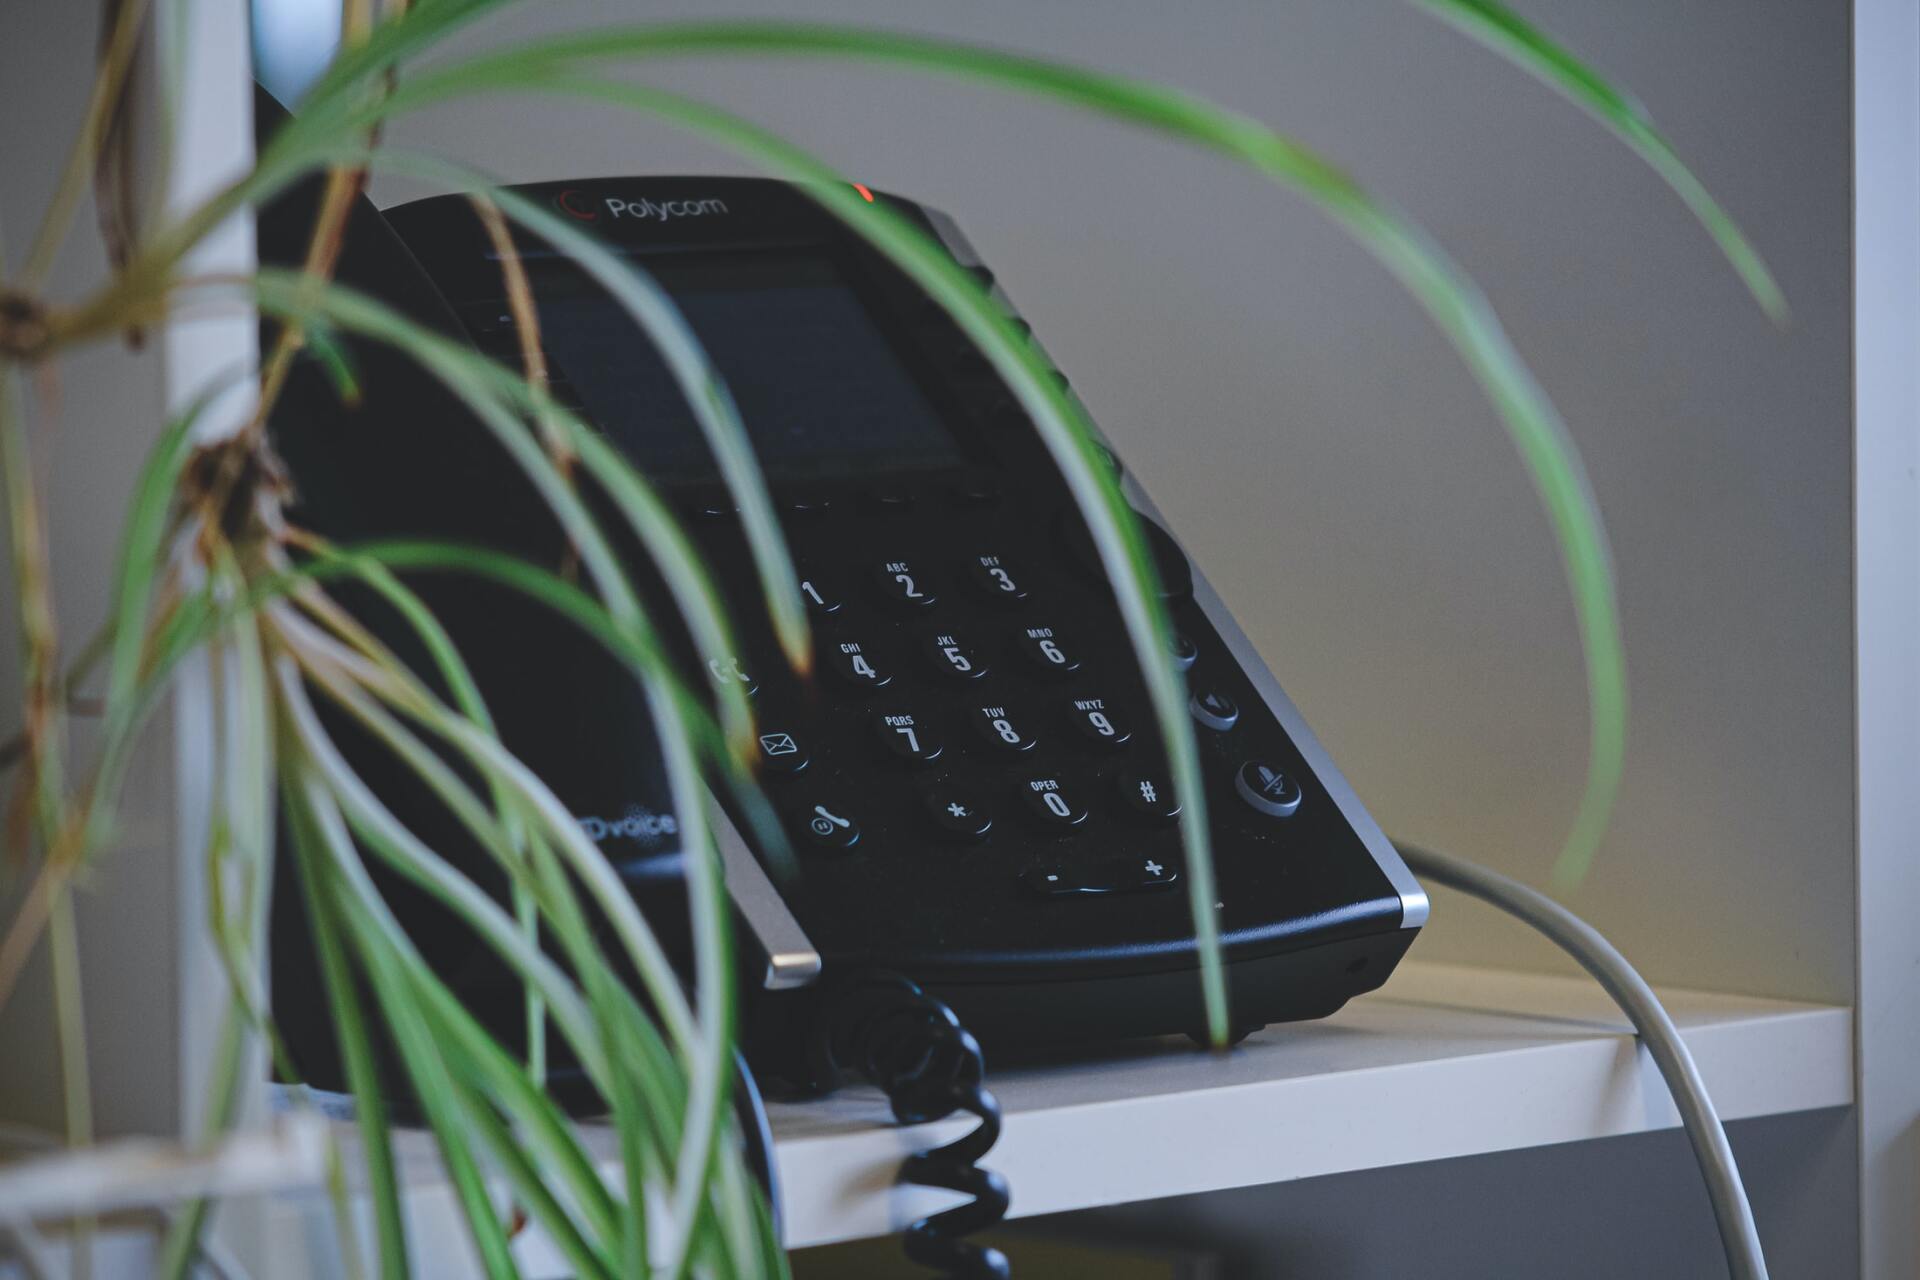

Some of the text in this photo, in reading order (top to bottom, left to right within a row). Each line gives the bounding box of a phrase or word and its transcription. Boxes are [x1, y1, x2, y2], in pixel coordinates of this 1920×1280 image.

[605, 198, 728, 221] Polycom
[886, 562, 909, 573] ABC
[895, 574, 924, 598] 2
[990, 568, 1016, 591] 3
[802, 581, 824, 604] 1
[937, 635, 957, 646] JKL
[1027, 628, 1053, 639] MNO
[840, 643, 861, 655] GHI
[943, 647, 972, 671] 5
[1039, 640, 1066, 664] 6
[852, 655, 877, 678] 4
[982, 707, 1005, 718] TUV
[1074, 699, 1105, 710] WXYZ
[884, 715, 915, 726] PQRS
[992, 719, 1021, 743] 8
[1088, 712, 1115, 736] 9
[896, 728, 920, 752] 7
[1030, 779, 1059, 791] OPER
[1139, 780, 1157, 803] #
[1043, 792, 1071, 817] 0
